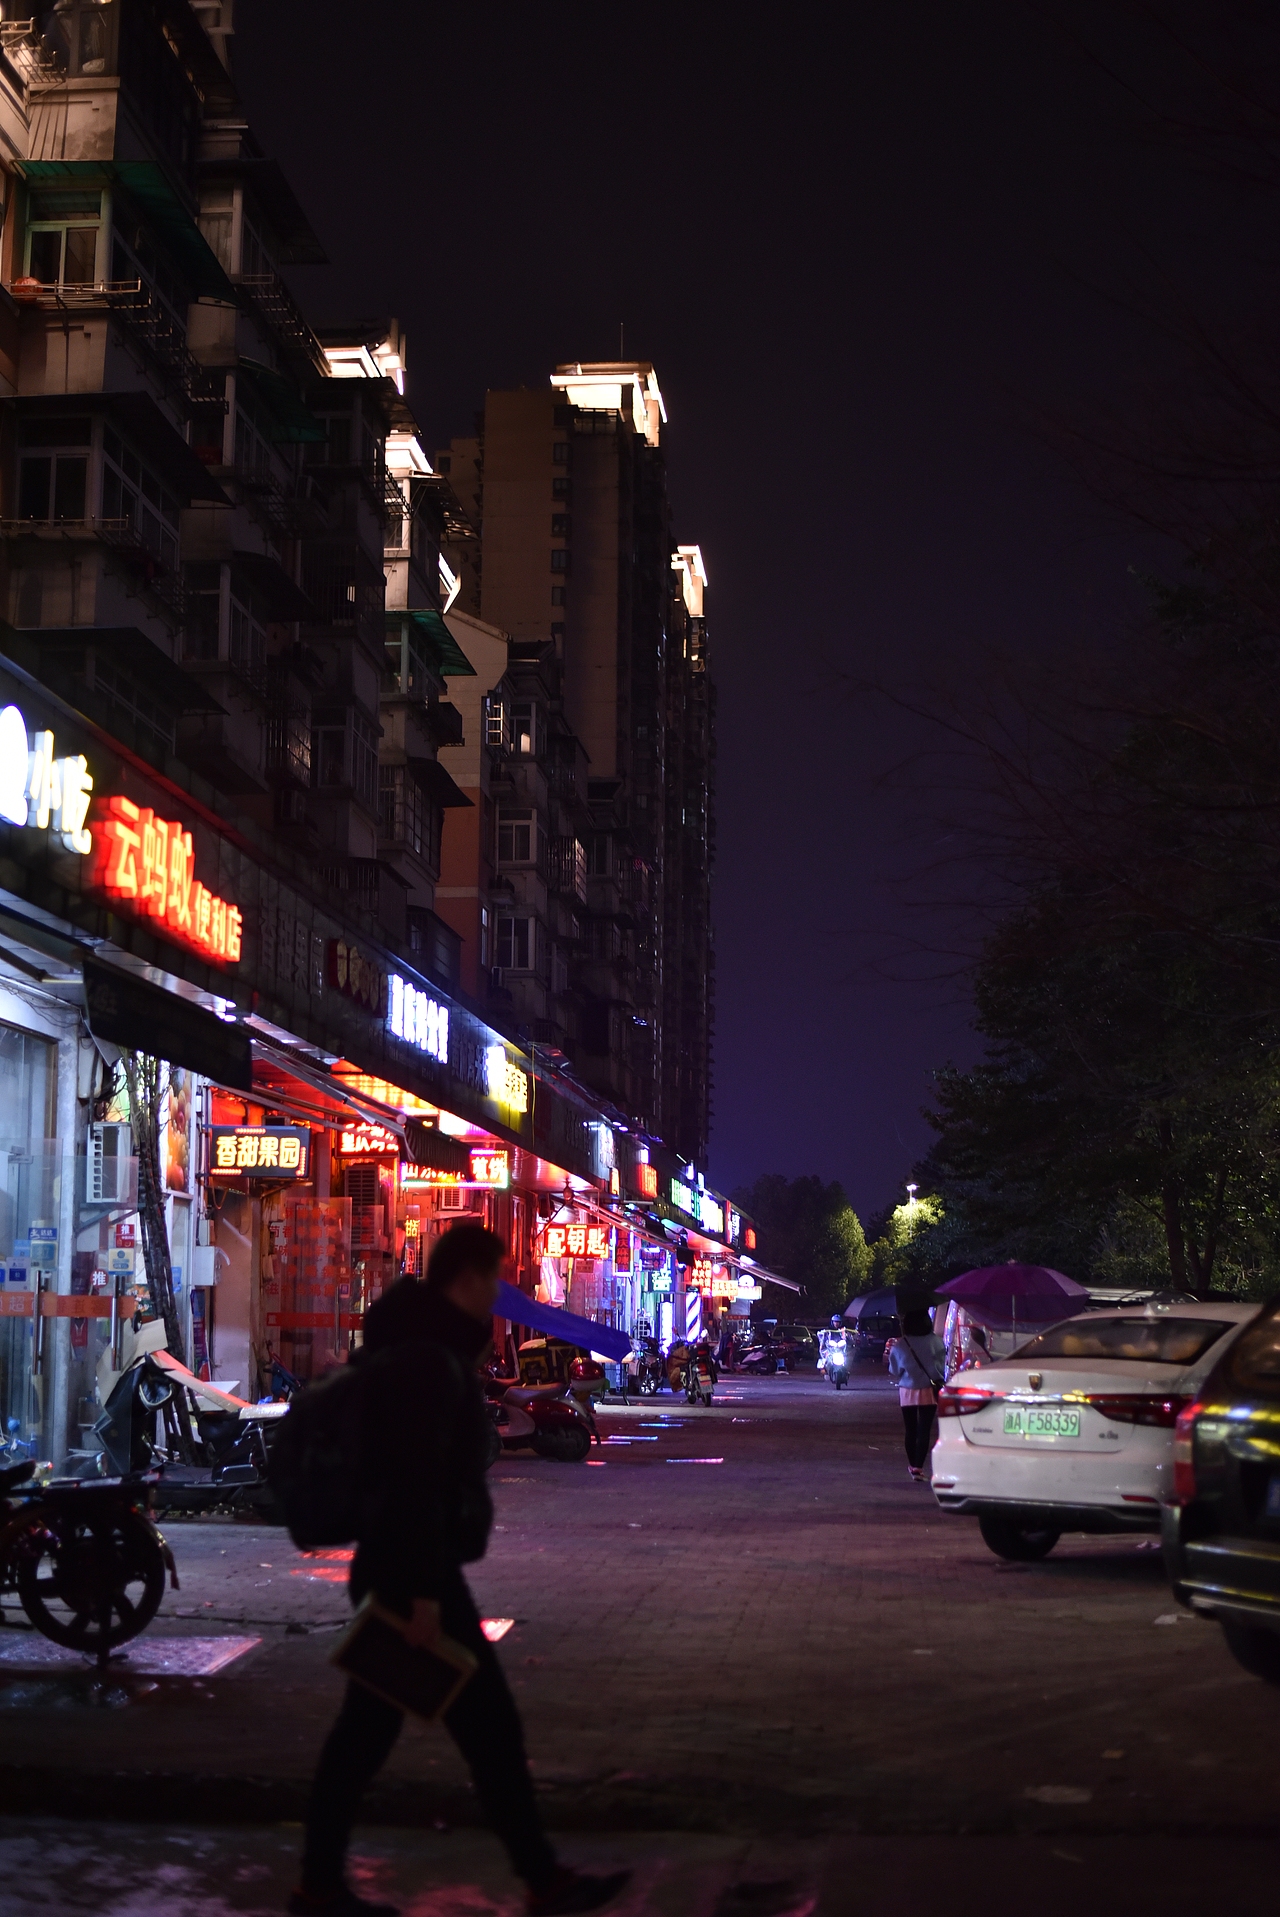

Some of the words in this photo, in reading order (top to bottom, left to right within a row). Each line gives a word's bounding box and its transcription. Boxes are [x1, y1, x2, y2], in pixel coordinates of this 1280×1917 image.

[28, 730, 93, 855] 小吃
[216, 1135, 300, 1168] 香甜果园
[547, 1228, 605, 1255] 配钥匙
[92, 1270, 107, 1286] 推
